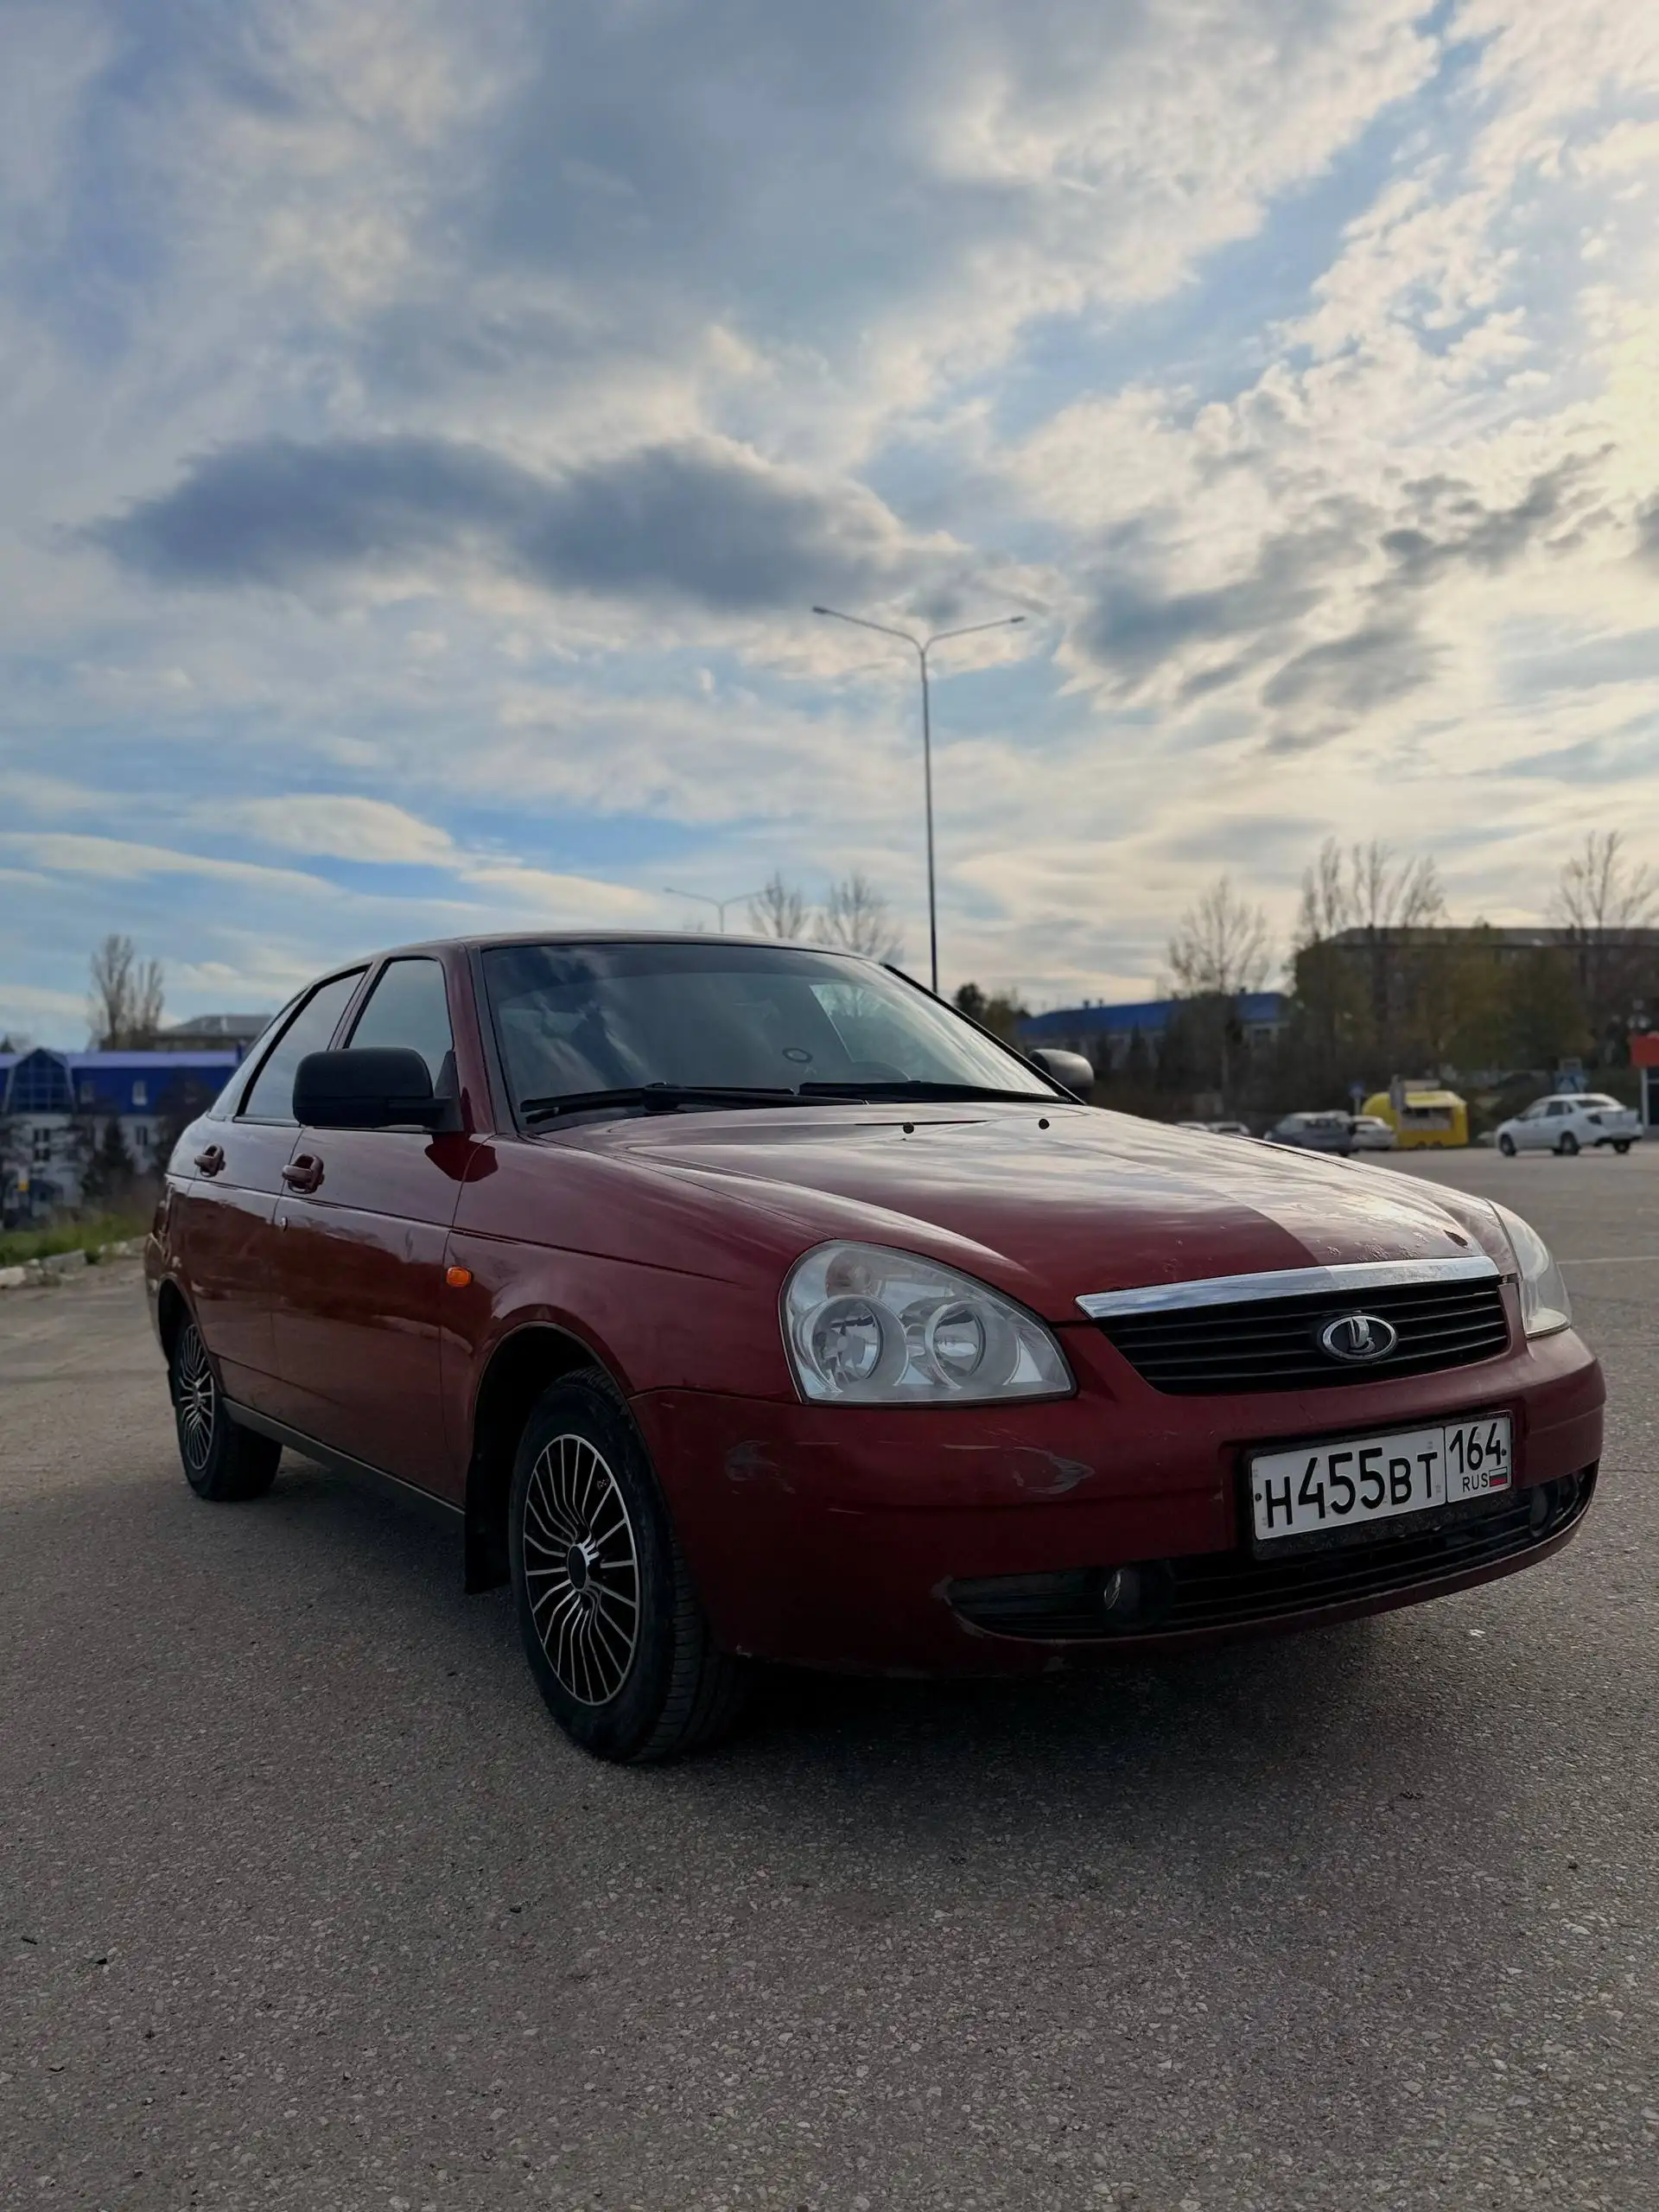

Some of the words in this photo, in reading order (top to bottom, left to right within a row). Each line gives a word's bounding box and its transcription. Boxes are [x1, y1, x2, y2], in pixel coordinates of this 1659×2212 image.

[1265, 1446, 1438, 1529] Н455ВТ
[1449, 1422, 1503, 1474] 164
[1462, 1474, 1489, 1493] RUS
